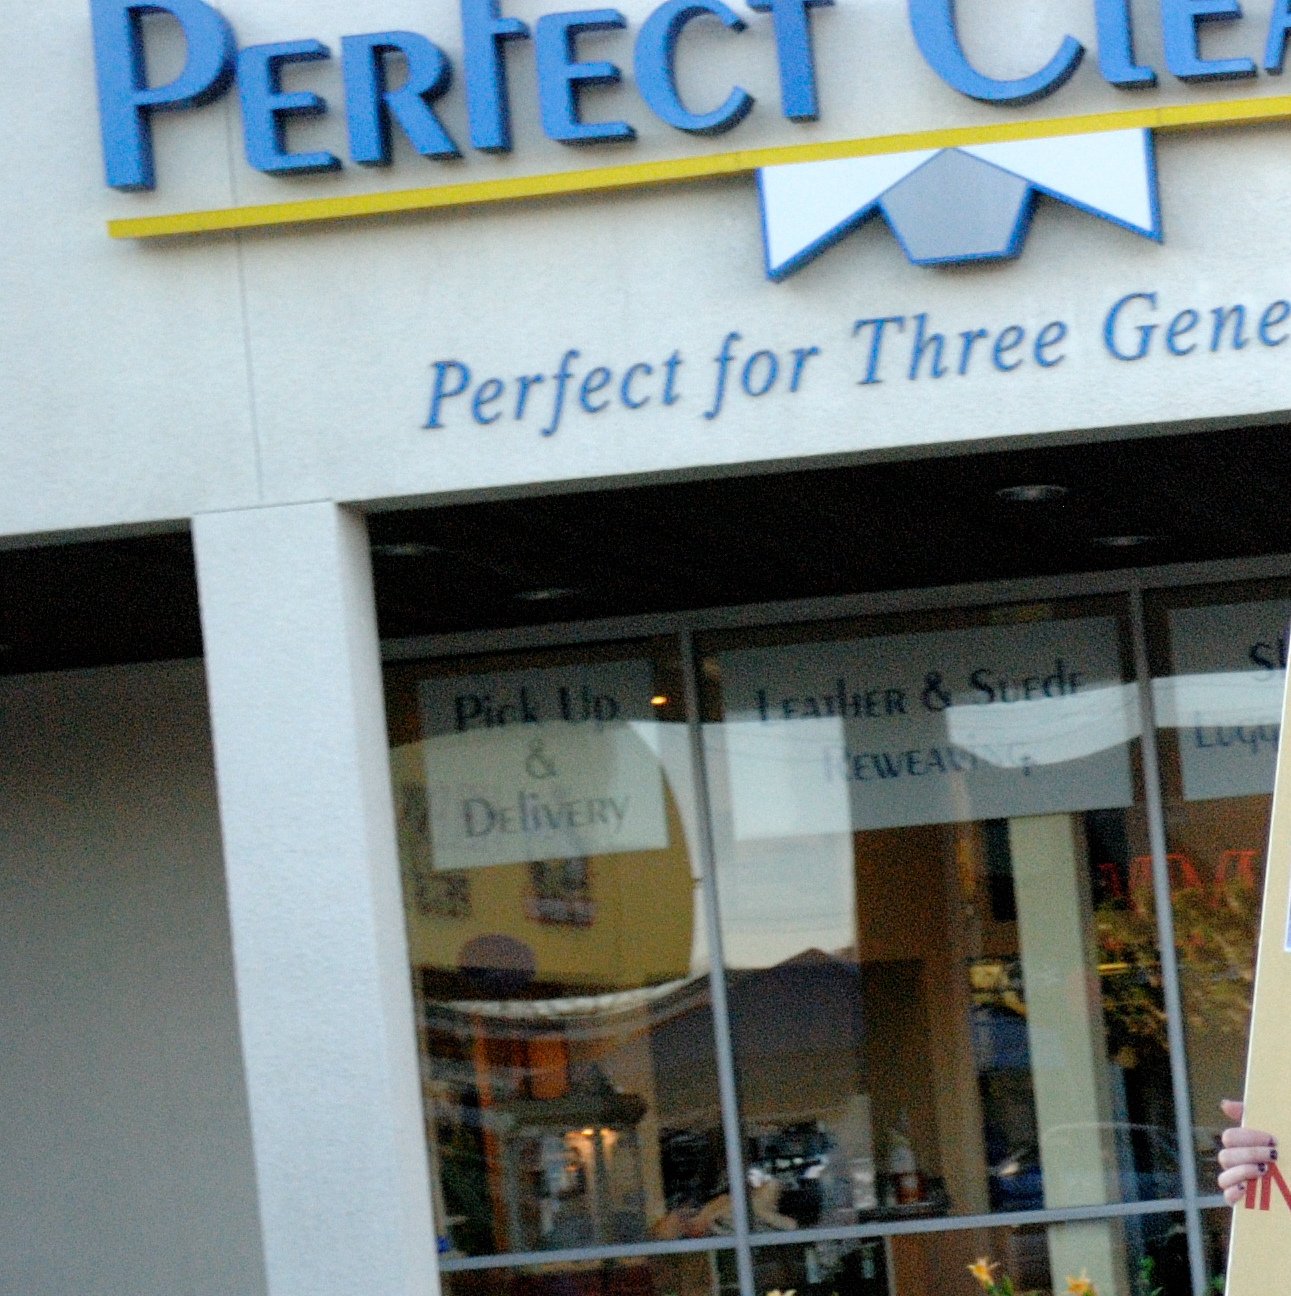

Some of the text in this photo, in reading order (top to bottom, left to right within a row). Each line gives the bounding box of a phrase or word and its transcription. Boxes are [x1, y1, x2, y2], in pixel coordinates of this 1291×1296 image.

[421, 347, 682, 436] Perfect
[702, 332, 820, 420] for
[851, 312, 1069, 387] Three
[919, 669, 952, 713] &
[525, 737, 557, 780] &
